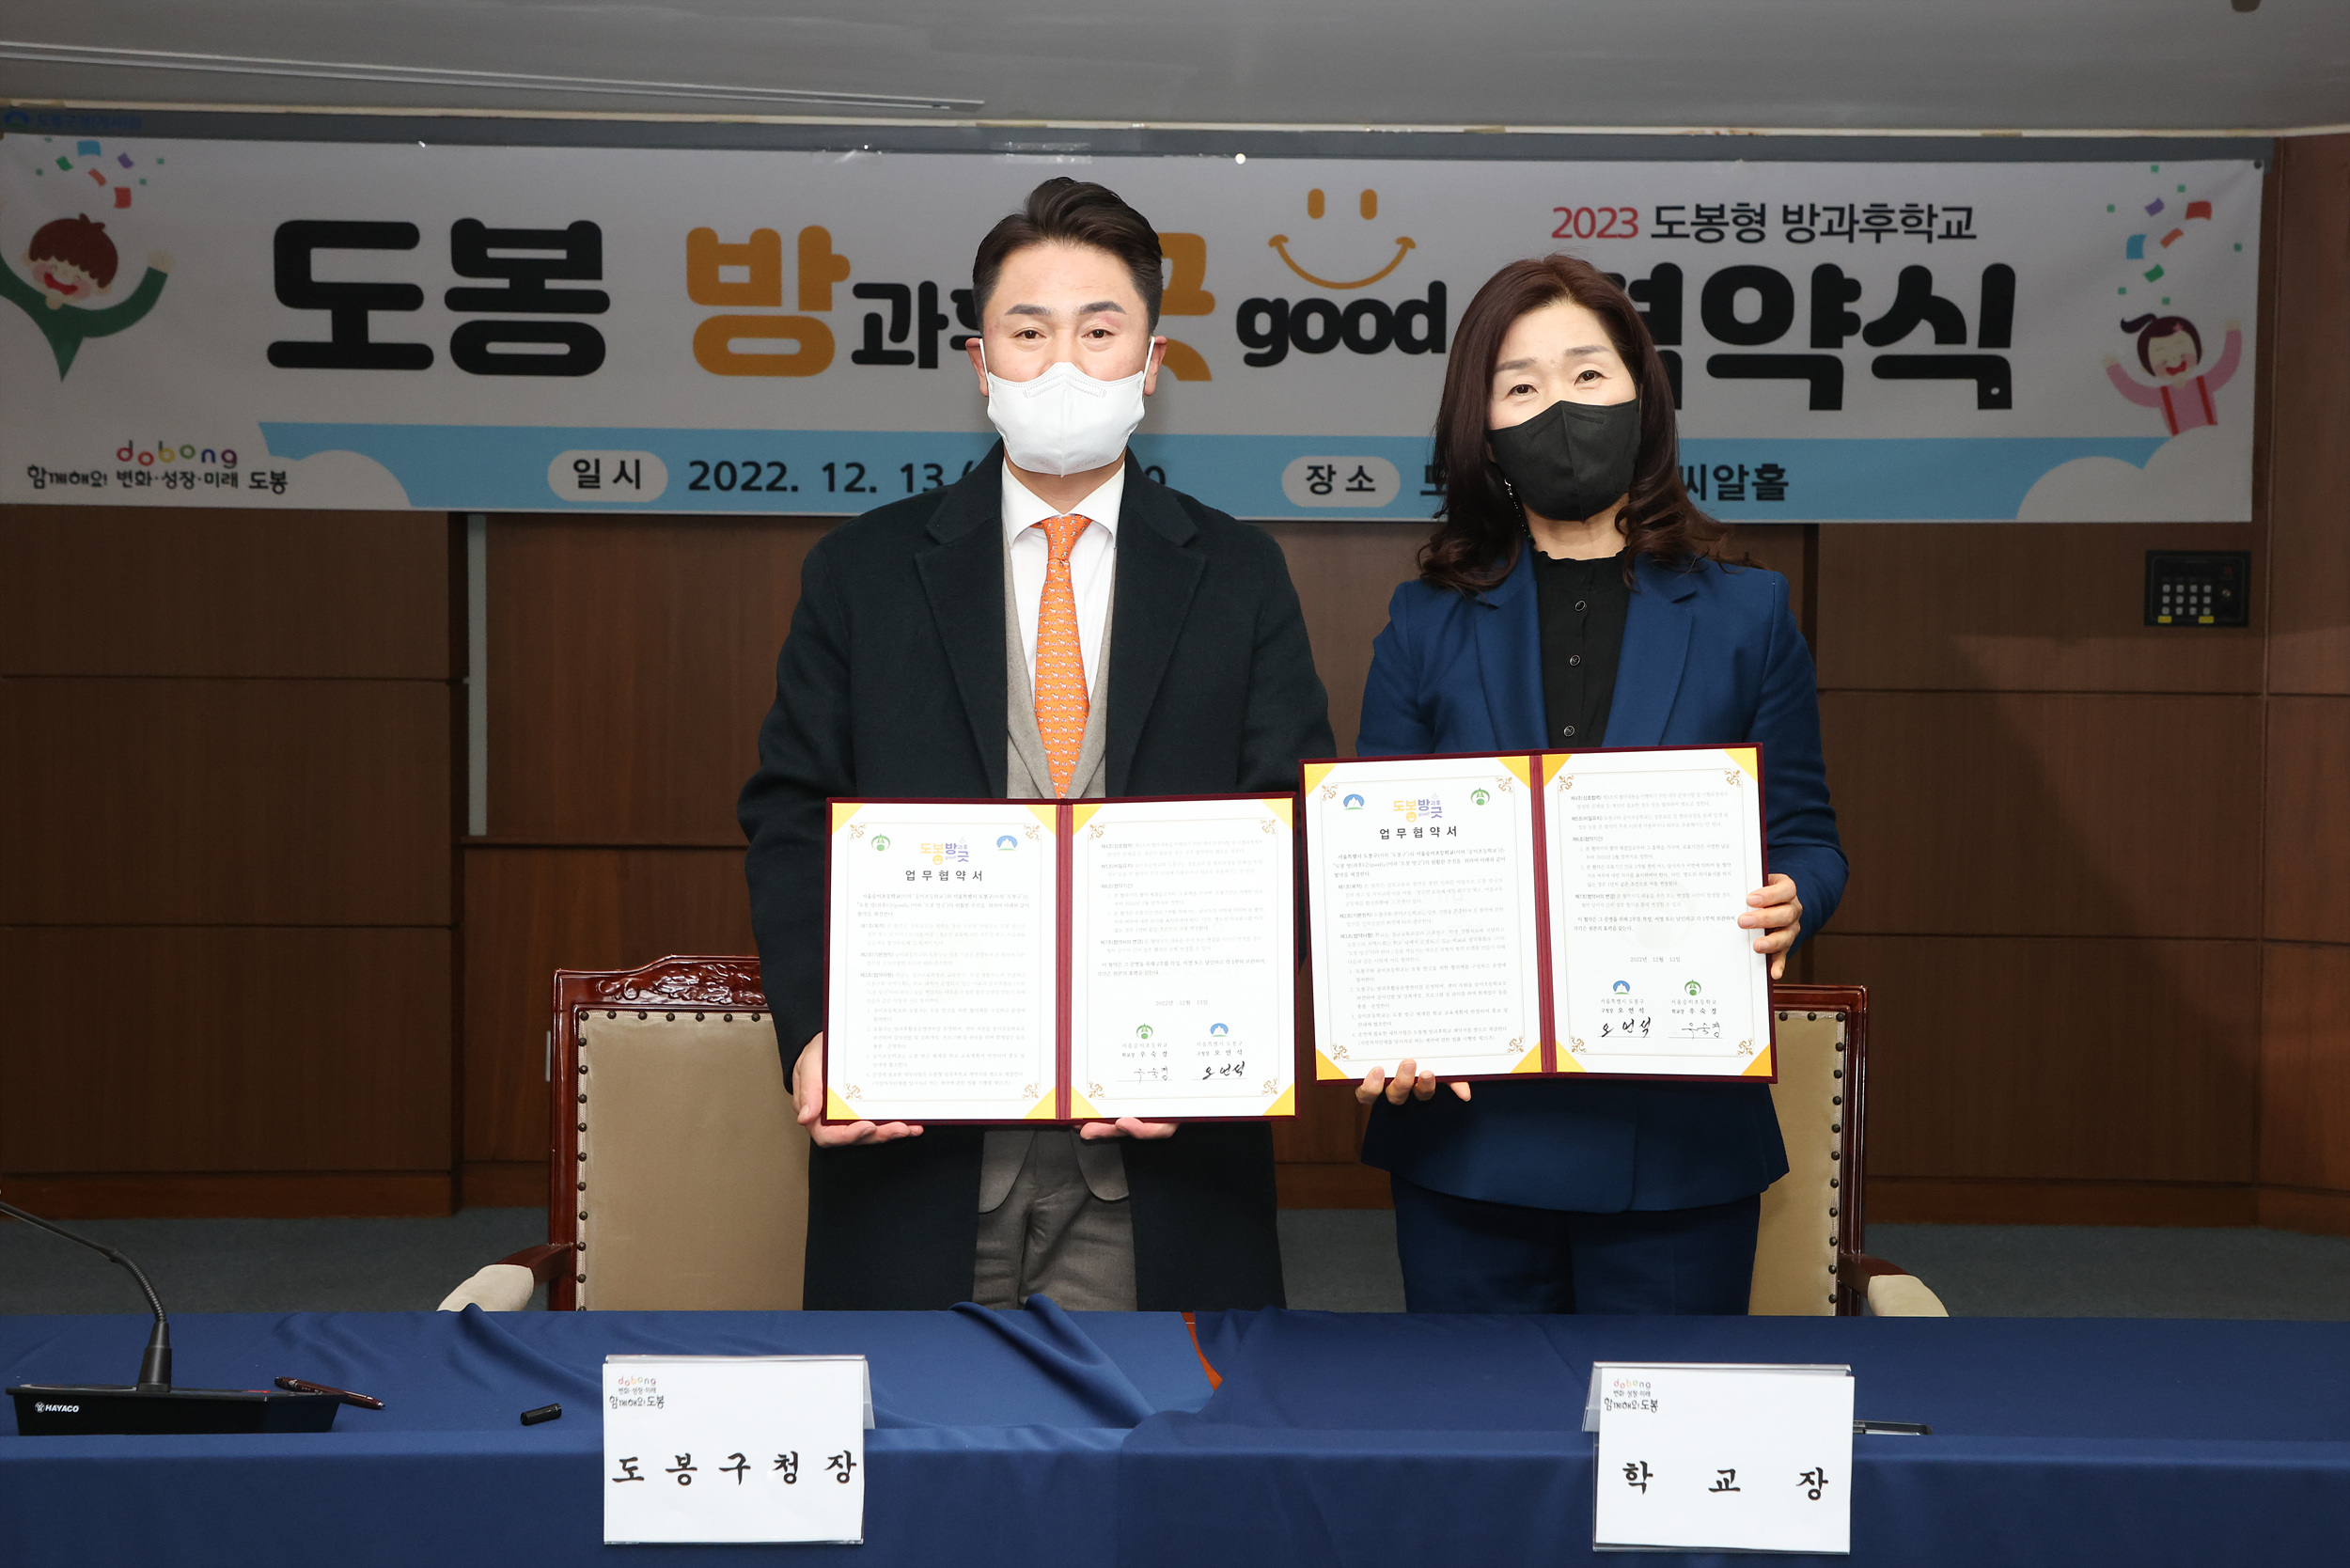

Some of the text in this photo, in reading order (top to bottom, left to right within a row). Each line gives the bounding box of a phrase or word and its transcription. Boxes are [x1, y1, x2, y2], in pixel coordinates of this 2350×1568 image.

[1552, 202, 1977, 243] 2023 도봉형 방과후학교
[267, 218, 610, 376] 도봉
[1236, 280, 1447, 368] good
[117, 440, 237, 468] dobong
[248, 471, 288, 494] 도봉
[688, 460, 798, 493] 2022.
[822, 462, 877, 493] 12.
[619, 1375, 656, 1387] dobong
[647, 1395, 666, 1409] 도봉
[1640, 1399, 1658, 1413] 도봉
[612, 1450, 857, 1486] 도봉구청장
